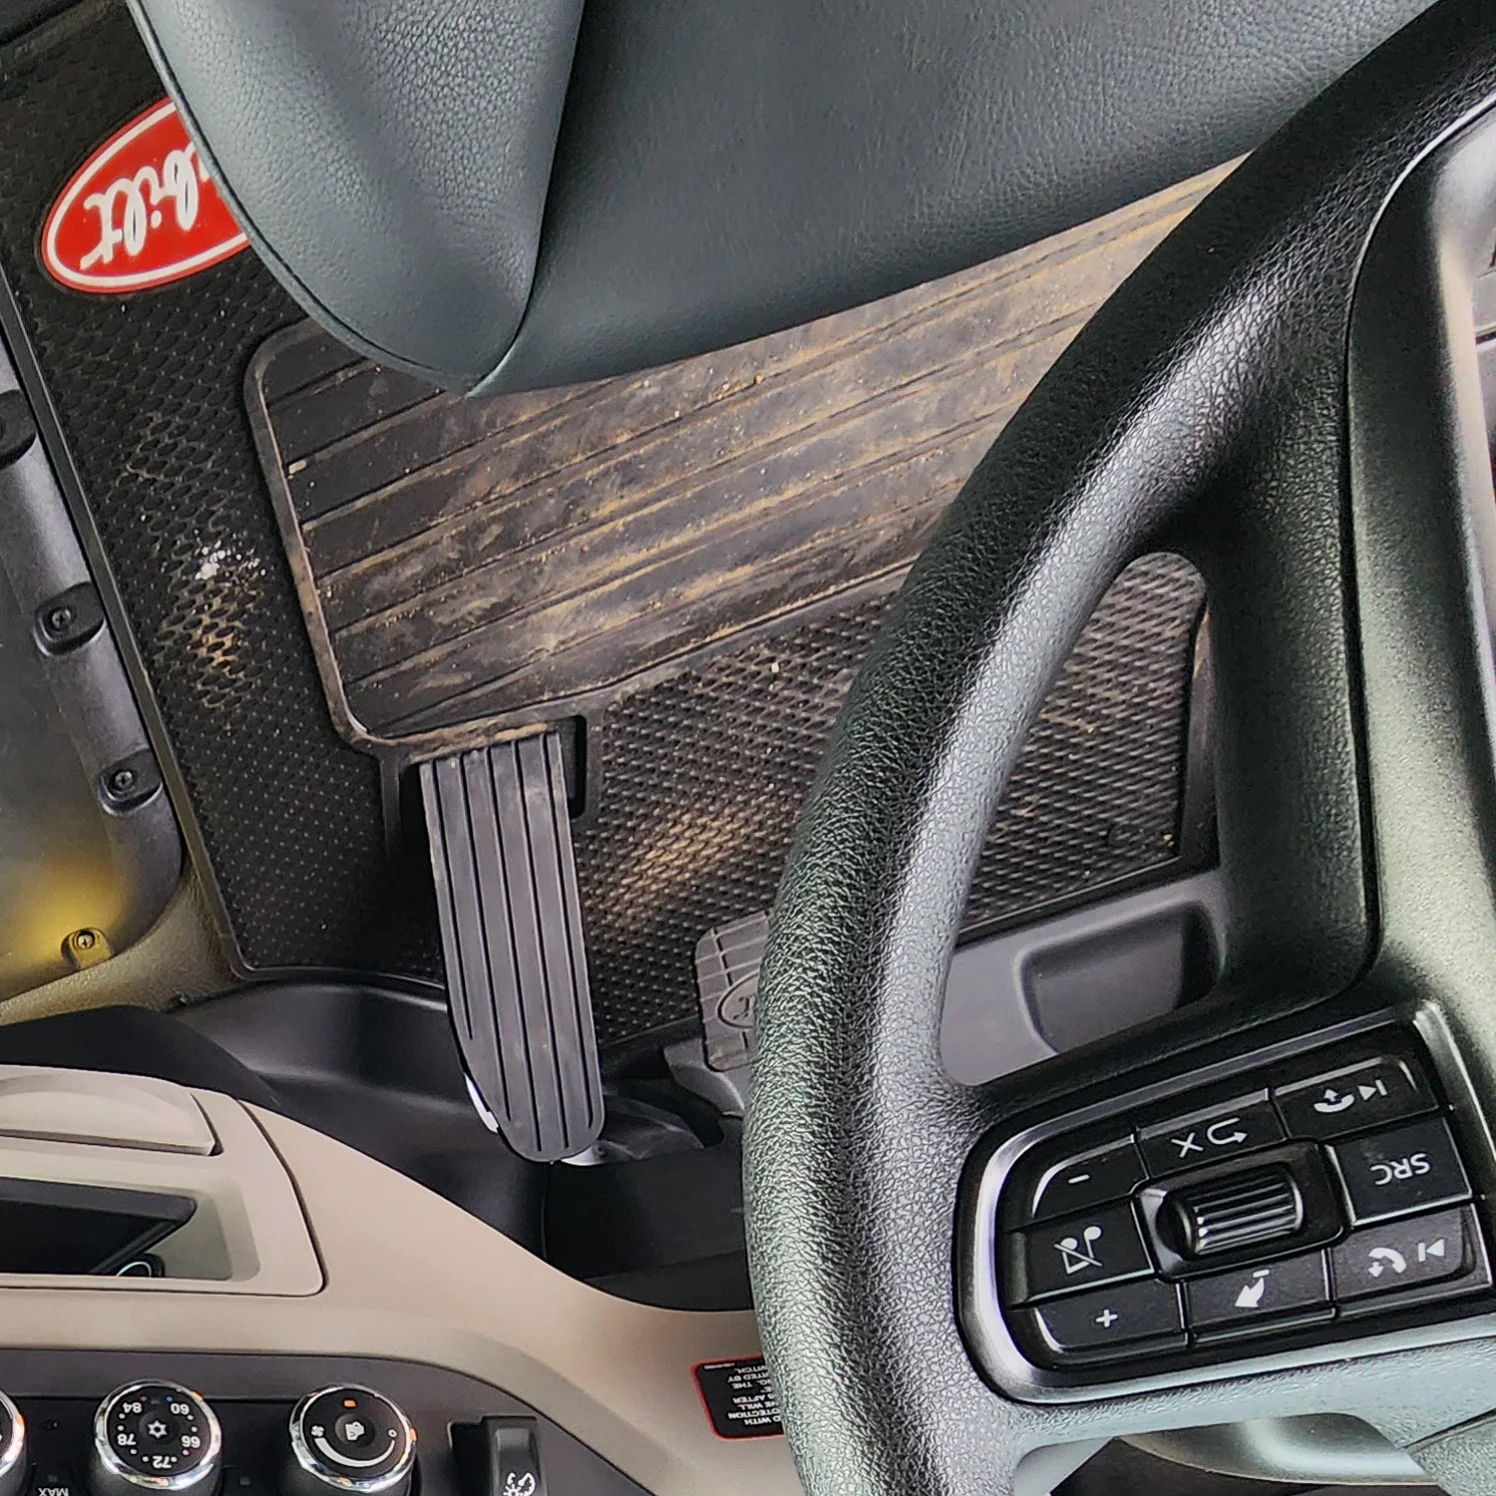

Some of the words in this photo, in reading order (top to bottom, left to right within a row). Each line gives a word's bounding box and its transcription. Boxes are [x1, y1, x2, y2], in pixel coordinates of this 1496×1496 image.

[1370, 1152, 1431, 1185] SRC
[732, 1394, 766, 1404] AFTER
[122, 1402, 143, 1414] 84
[170, 1402, 190, 1415] 60
[737, 1402, 764, 1411] WILL
[727, 1407, 779, 1419] OTECTION
[743, 1417, 772, 1426] WITH
[116, 1432, 136, 1445] 78
[181, 1435, 201, 1448] 66
[152, 1455, 173, 1468] 72
[37, 1487, 69, 1496] MAX
